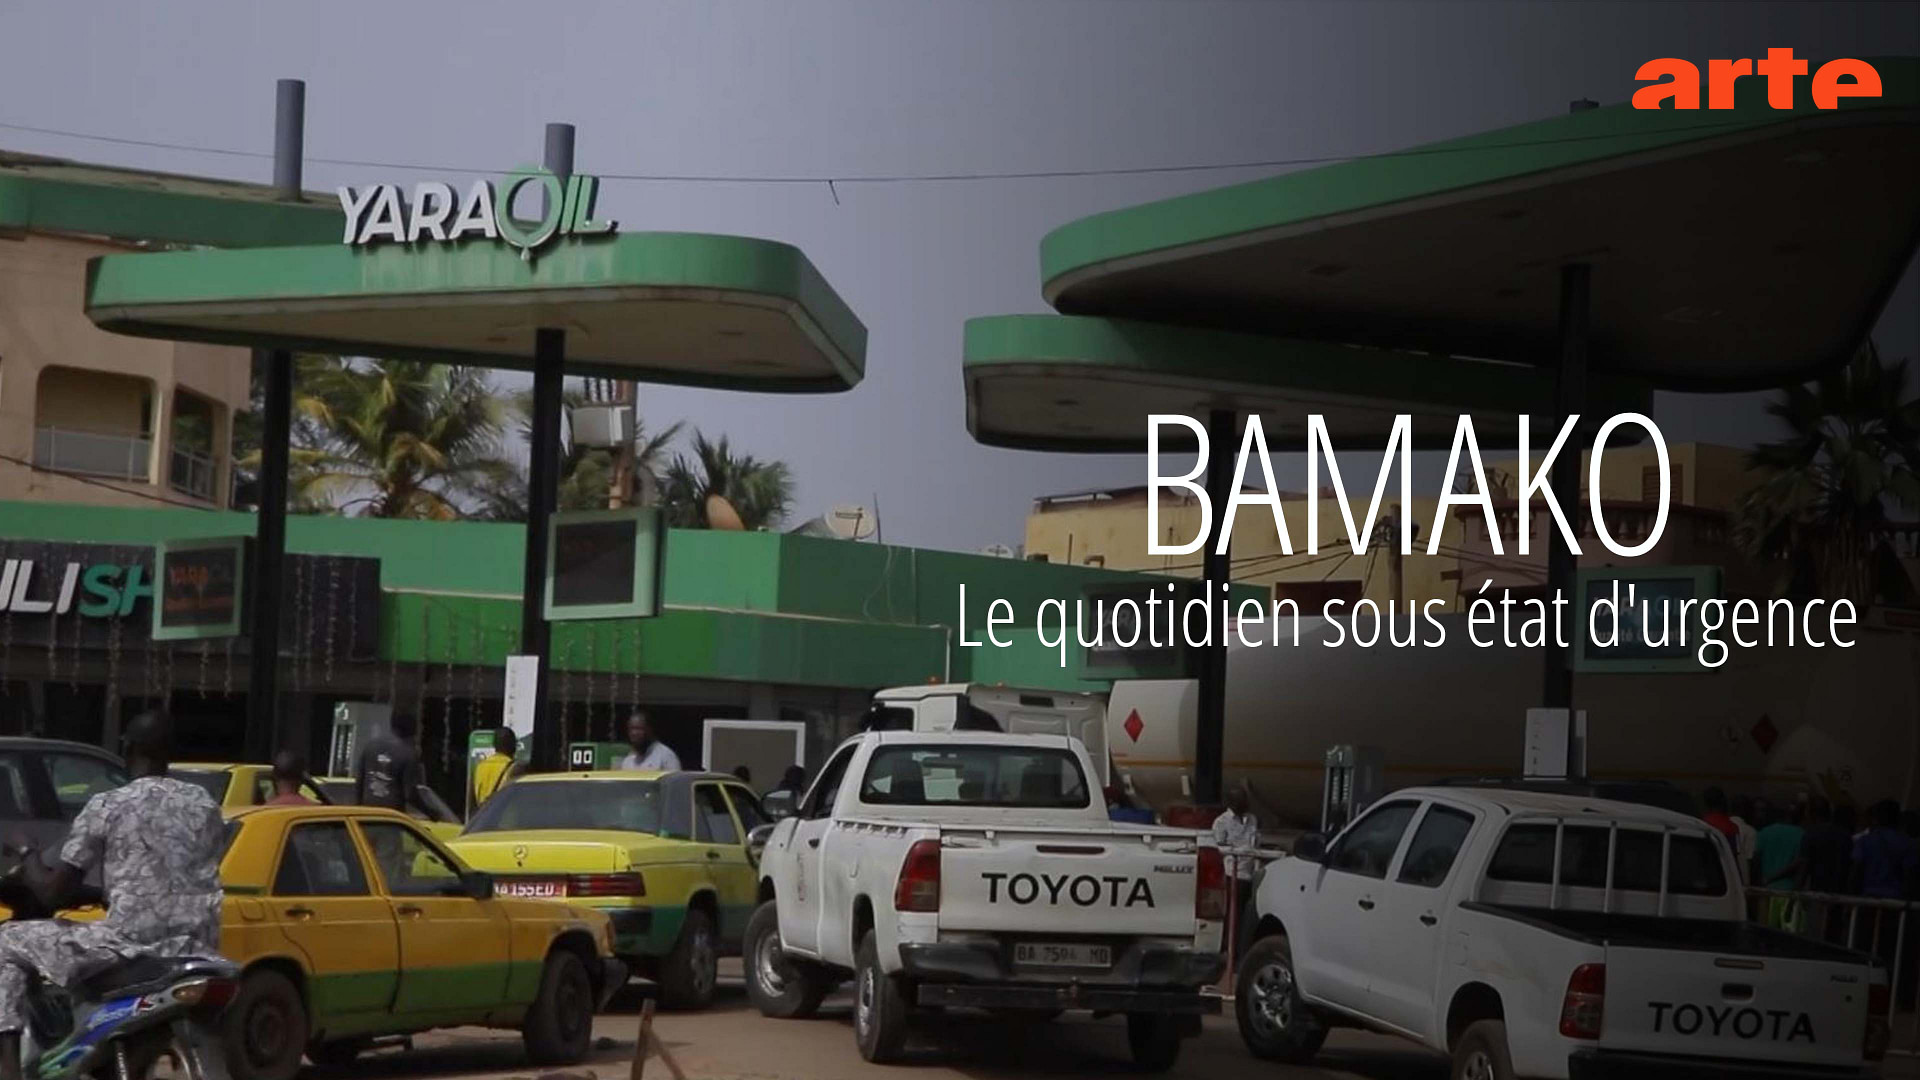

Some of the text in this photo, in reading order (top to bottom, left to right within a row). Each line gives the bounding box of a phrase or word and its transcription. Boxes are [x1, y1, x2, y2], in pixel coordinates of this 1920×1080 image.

[337, 165, 617, 259] YARAOIL
[981, 872, 1155, 909] TOYOTA
[1648, 1001, 1816, 1044] TOYOTA
